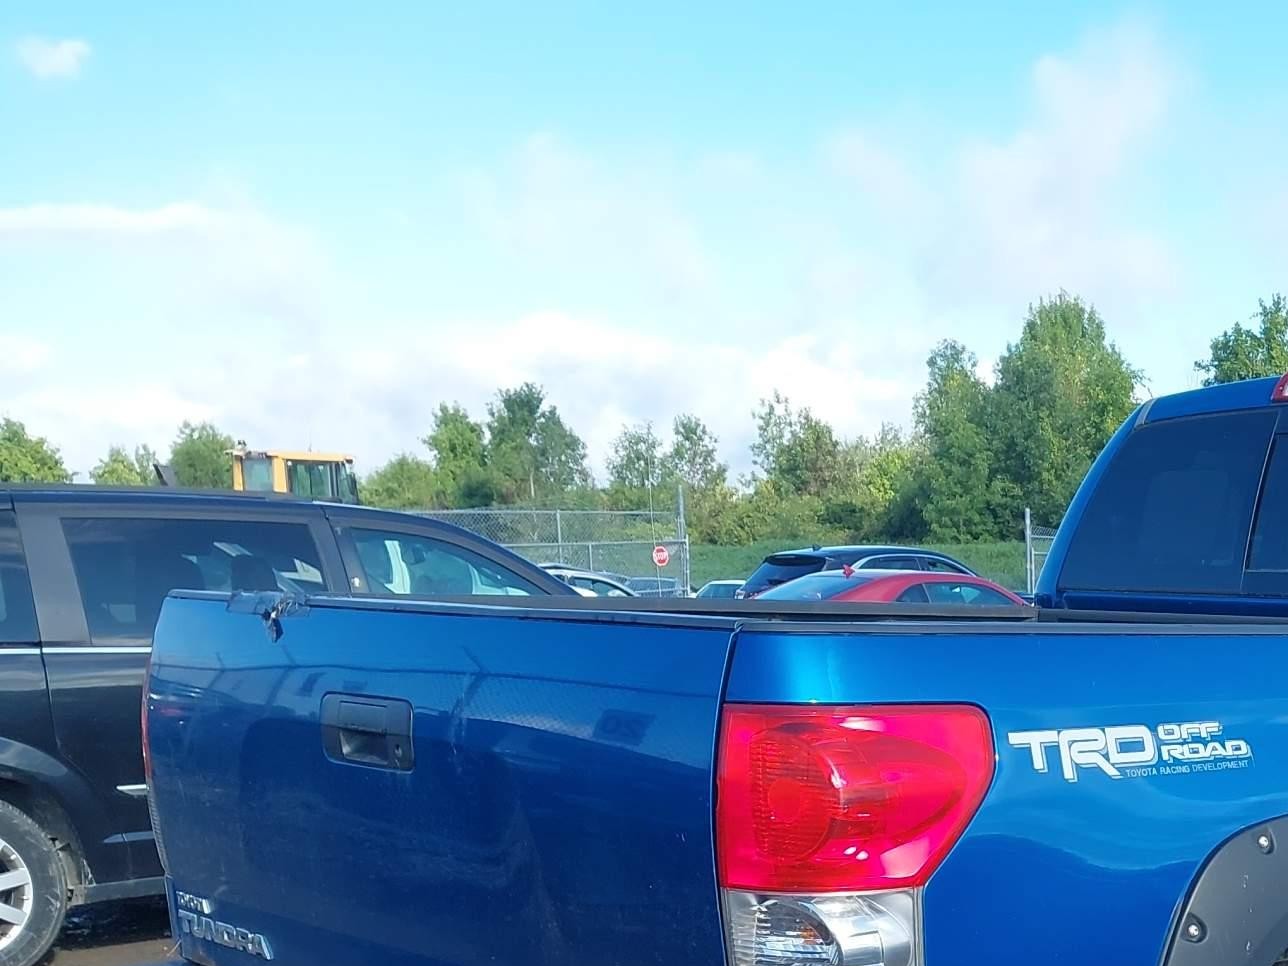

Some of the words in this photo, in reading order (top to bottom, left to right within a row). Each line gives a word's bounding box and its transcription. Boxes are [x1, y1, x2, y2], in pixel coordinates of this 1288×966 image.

[1157, 721, 1222, 742] OFF
[1008, 725, 1158, 782] TRD
[1161, 740, 1251, 762] ROAD
[1126, 767, 1158, 778] TOYOTA
[1160, 764, 1190, 775] RACING
[1191, 759, 1248, 774] DEVELOPMENT
[178, 908, 274, 960] TUNDRA
